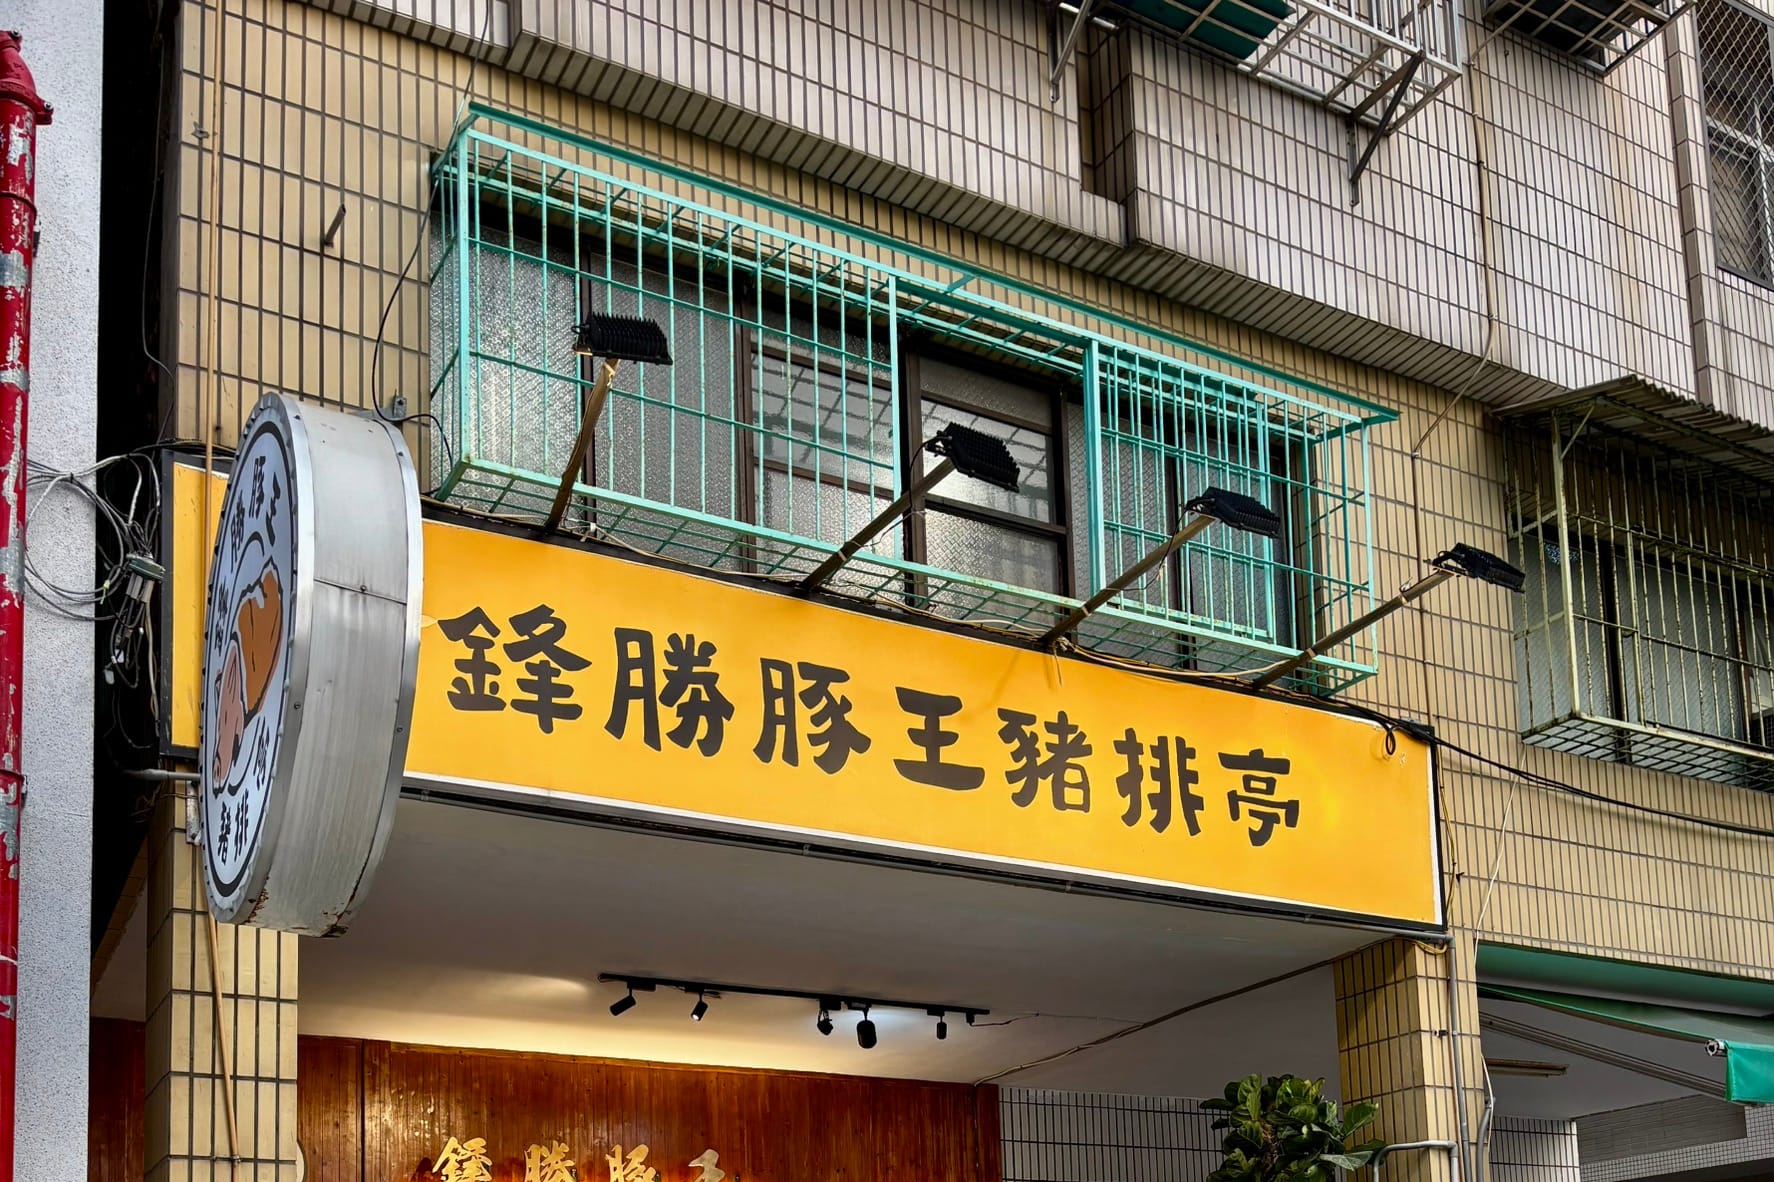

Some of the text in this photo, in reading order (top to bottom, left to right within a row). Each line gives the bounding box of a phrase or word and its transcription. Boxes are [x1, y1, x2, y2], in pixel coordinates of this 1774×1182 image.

[438, 604, 1299, 846] 鋒勝豚王豬排亭
